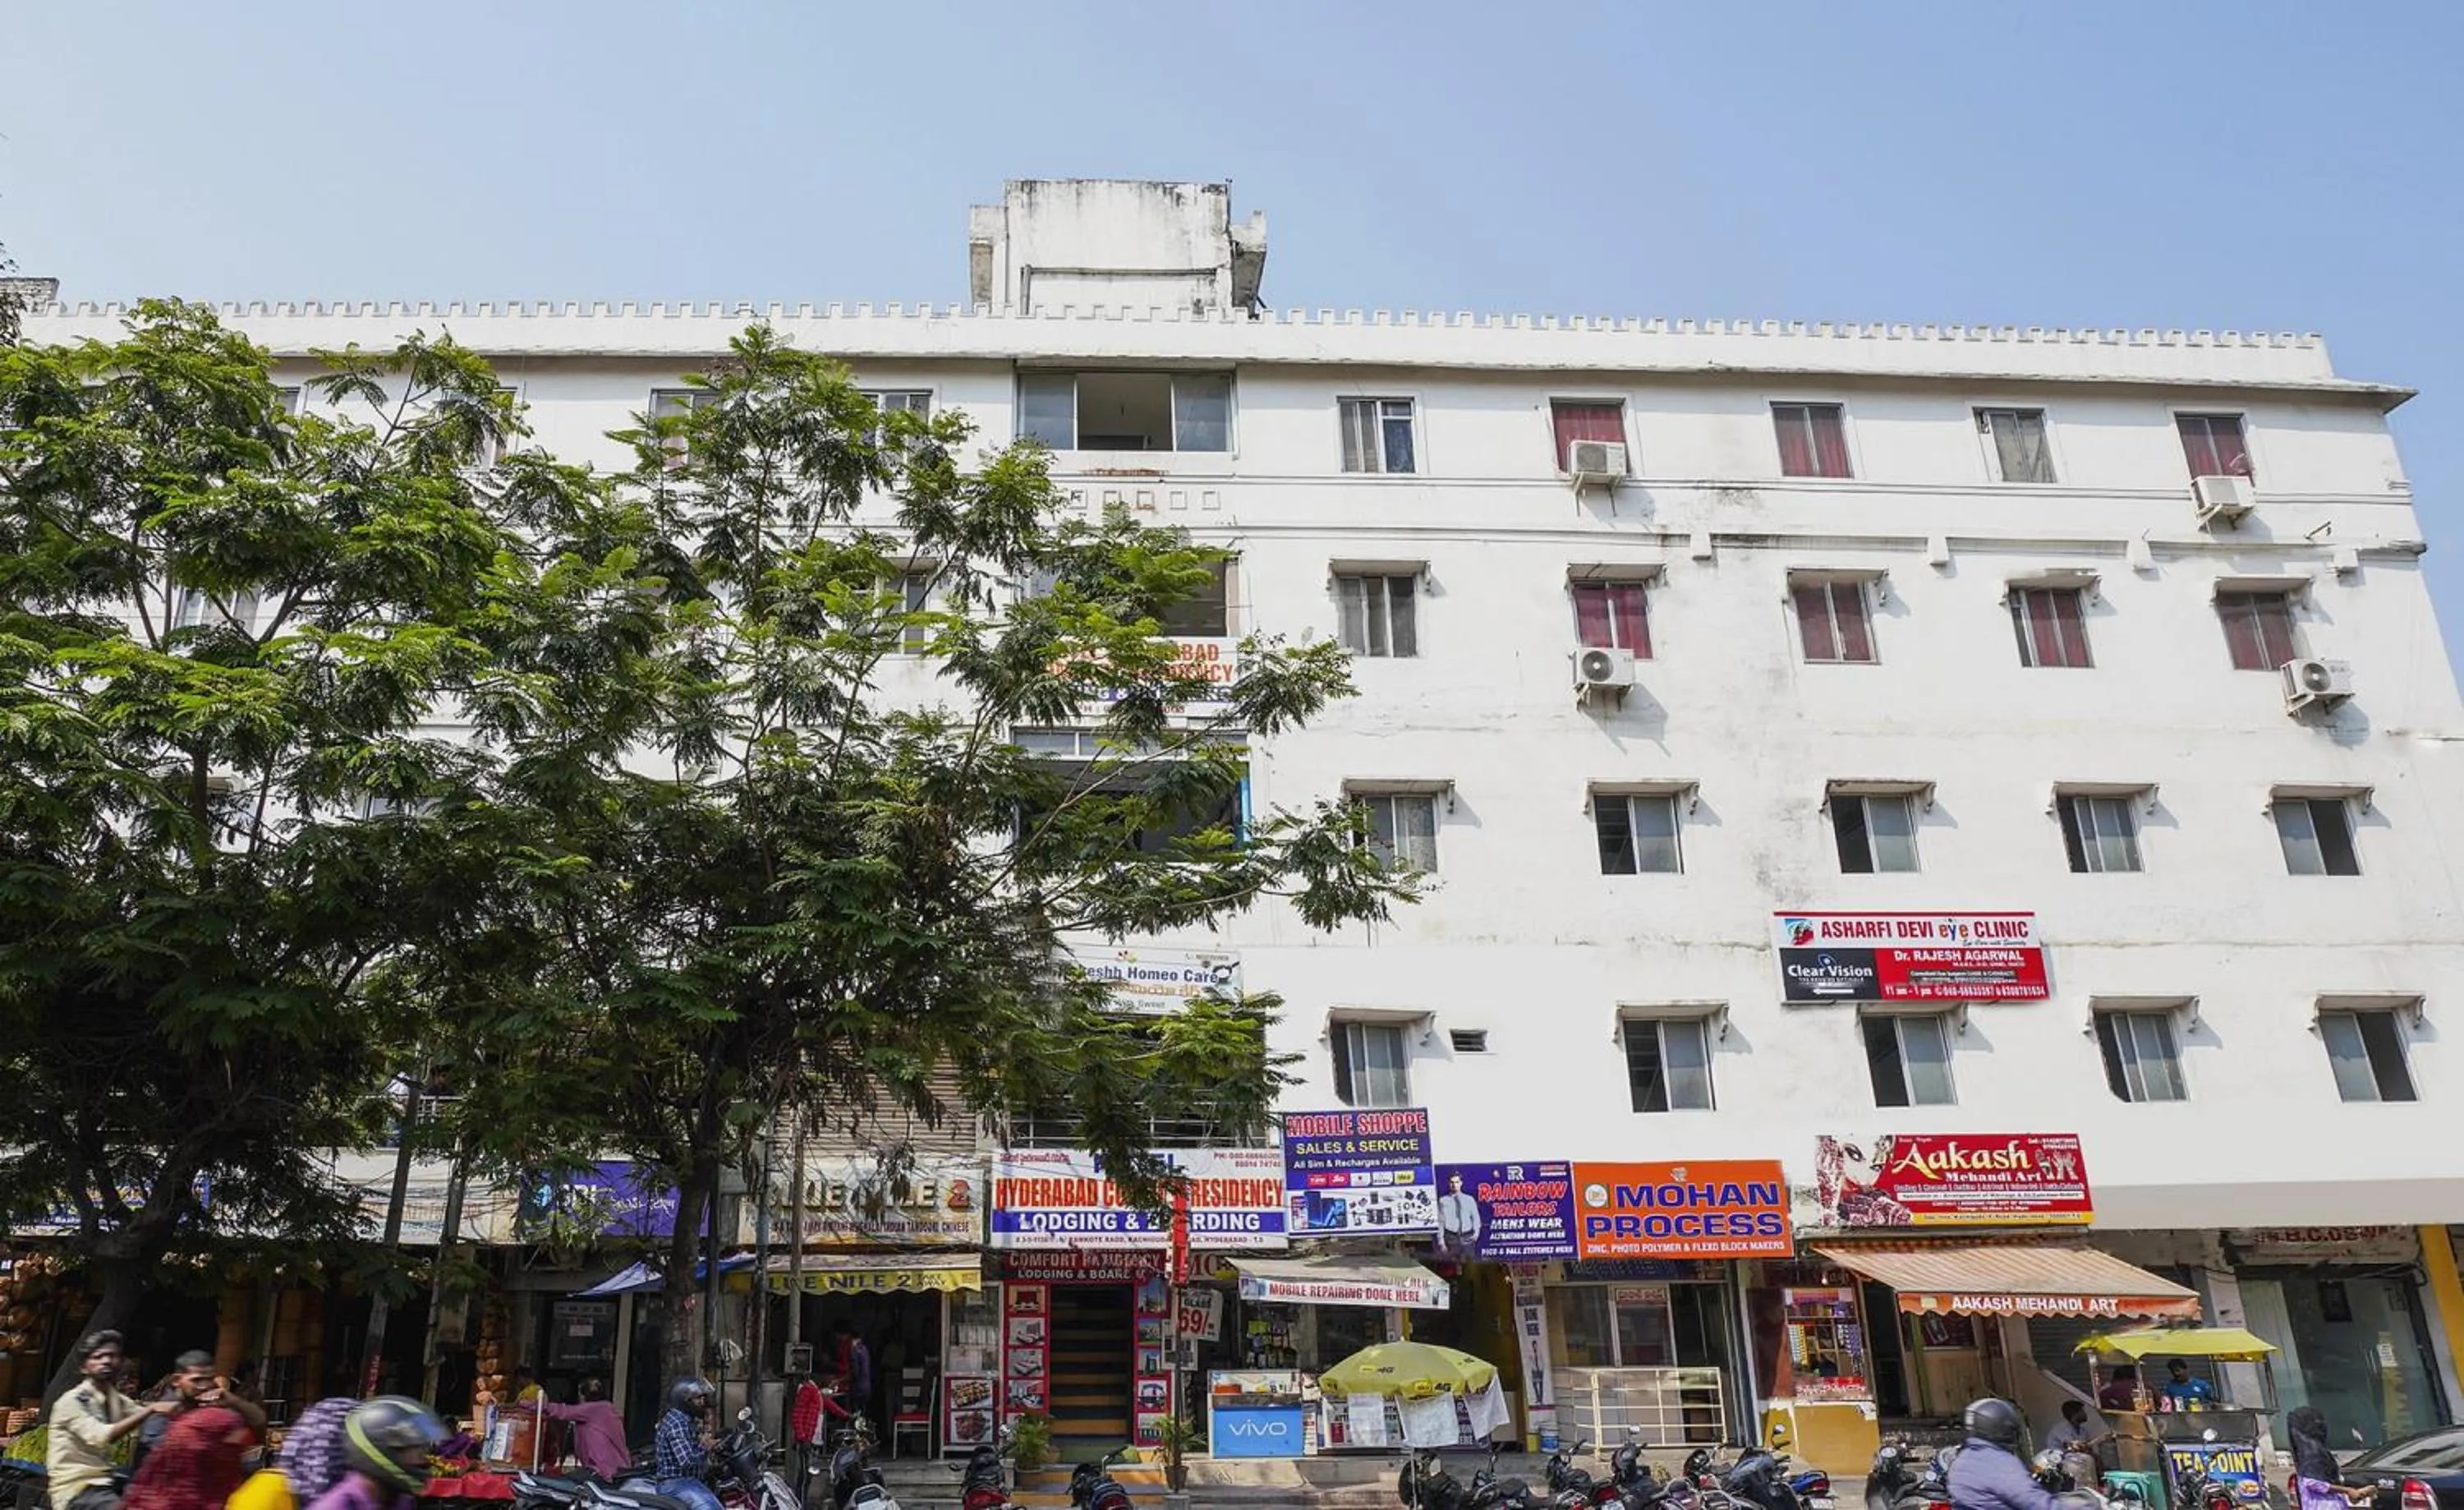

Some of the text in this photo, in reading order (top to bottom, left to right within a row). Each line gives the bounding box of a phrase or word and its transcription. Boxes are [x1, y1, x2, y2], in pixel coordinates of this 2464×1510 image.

[1821, 919, 2029, 941] ASHARFI DEVI eye CLINIC
[1894, 951, 2024, 961] Dr. RAJESH AGARWAL
[1128, 968, 1179, 982] Homeo
[1184, 969, 1219, 983] Care
[1787, 964, 1873, 977] Clear Vision
[1287, 1112, 1427, 1137] MOBILE SHOPPE
[1296, 1139, 1419, 1154] SALES & SERVICE
[1308, 1160, 1324, 1168] Sim
[1335, 1158, 1381, 1167] Recharges
[1383, 1156, 1421, 1166] Available
[1892, 1140, 2032, 1180] Aakash
[1945, 1172, 2042, 1181] Mehandi Art
[947, 1179, 971, 1208] 2
[995, 1178, 1099, 1208] HYDERABAD
[1190, 1179, 1282, 1207] RESIDENCY
[1478, 1181, 1567, 1201] RAINBOW
[1615, 1183, 1781, 1208] MOHAN
[1492, 1201, 1557, 1217] TAILORS
[1019, 1213, 1117, 1231] LODGING
[1125, 1213, 1140, 1230] &
[1490, 1218, 1563, 1230] MENS WEAR
[1585, 1213, 1784, 1240] PROCESS
[1611, 1245, 1639, 1253] PHOTO
[1642, 1244, 1681, 1253] POLYMER
[1683, 1243, 1690, 1251] &
[1692, 1243, 1718, 1251] FLEXO
[1721, 1242, 1749, 1251] BLOCK
[1750, 1241, 1785, 1250] MAKERS
[1010, 1254, 1078, 1266] COMFORT
[830, 1274, 886, 1289] NILE
[897, 1274, 912, 1288] 2
[1018, 1270, 1073, 1279] LODGING
[1078, 1269, 1086, 1279] &
[1269, 1283, 1420, 1302] MOBILE REPAIRING DONE HERE
[1951, 1296, 2118, 1313] AAKASH MEHANDI ART
[1229, 1419, 1287, 1436] vivo
[2173, 1452, 2255, 1473] TEA POINT
